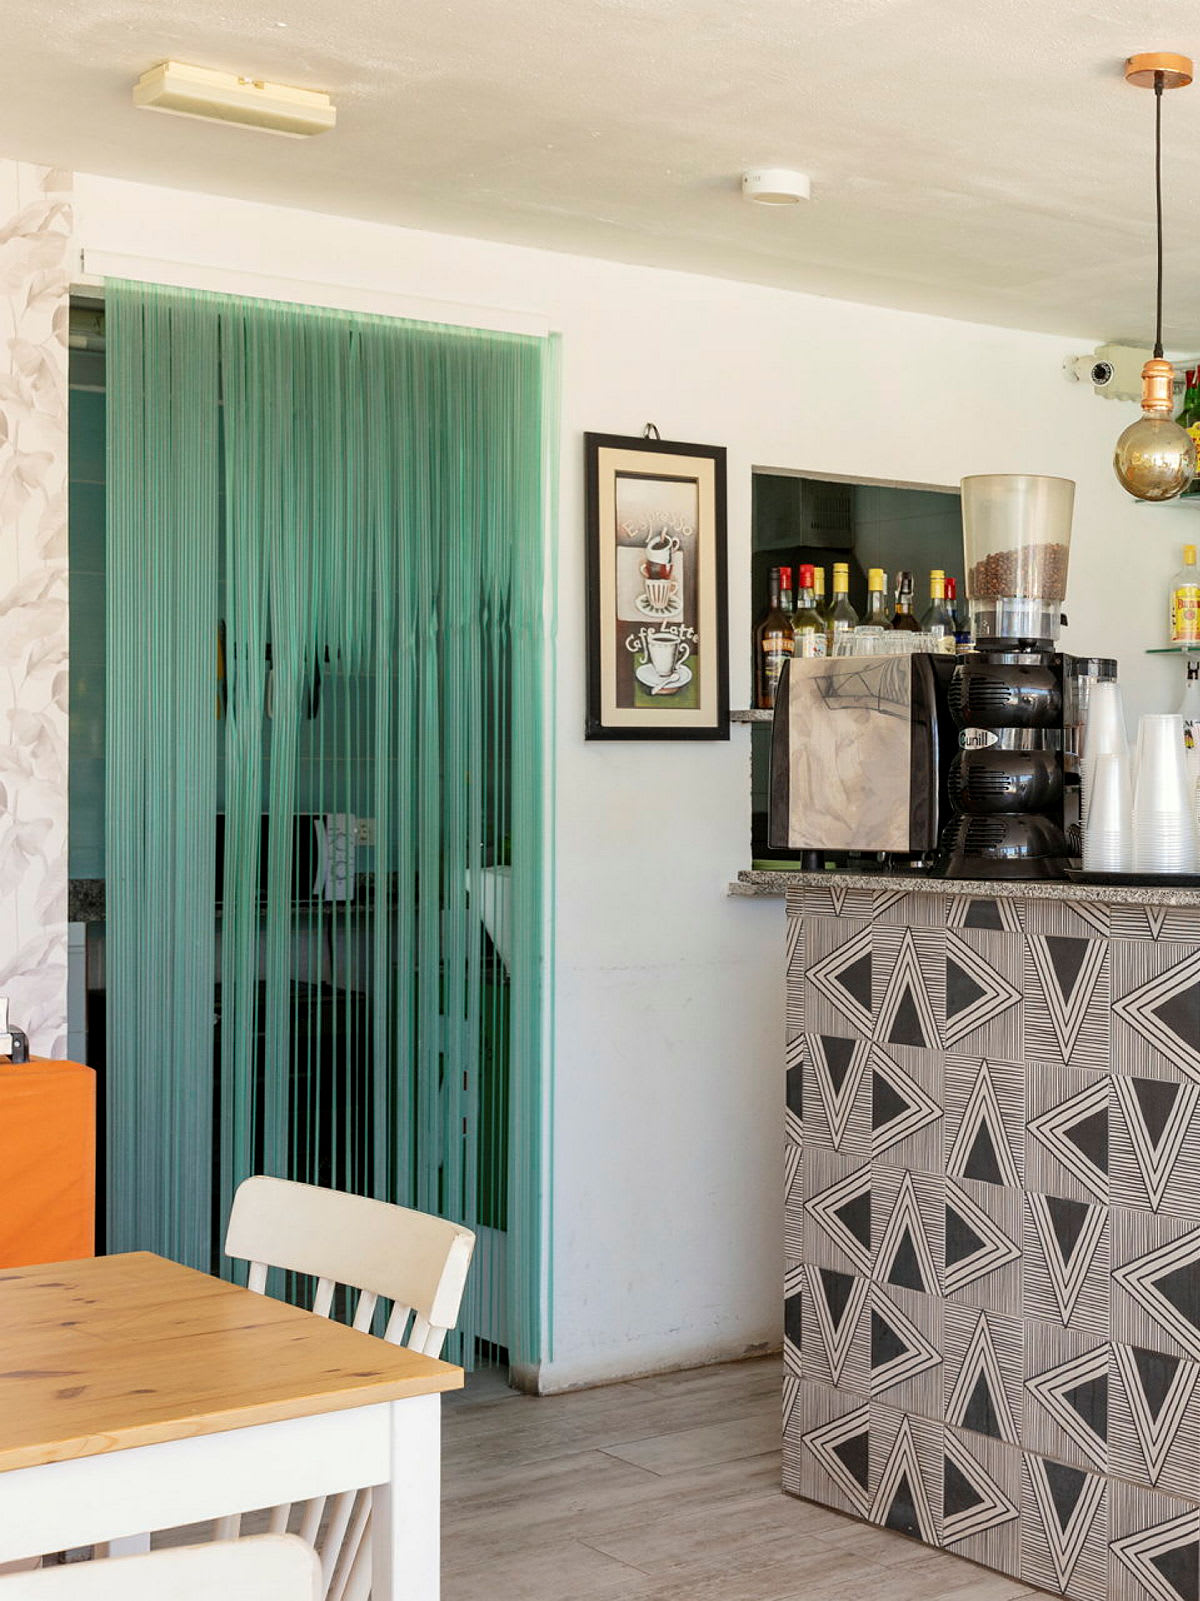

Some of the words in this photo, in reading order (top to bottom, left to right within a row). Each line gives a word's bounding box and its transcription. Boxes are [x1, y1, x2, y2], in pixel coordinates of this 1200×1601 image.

[623, 510, 693, 543] Espresso
[625, 627, 657, 664] Cafe
[660, 619, 700, 644] Latte
[961, 731, 988, 746] Cunill
